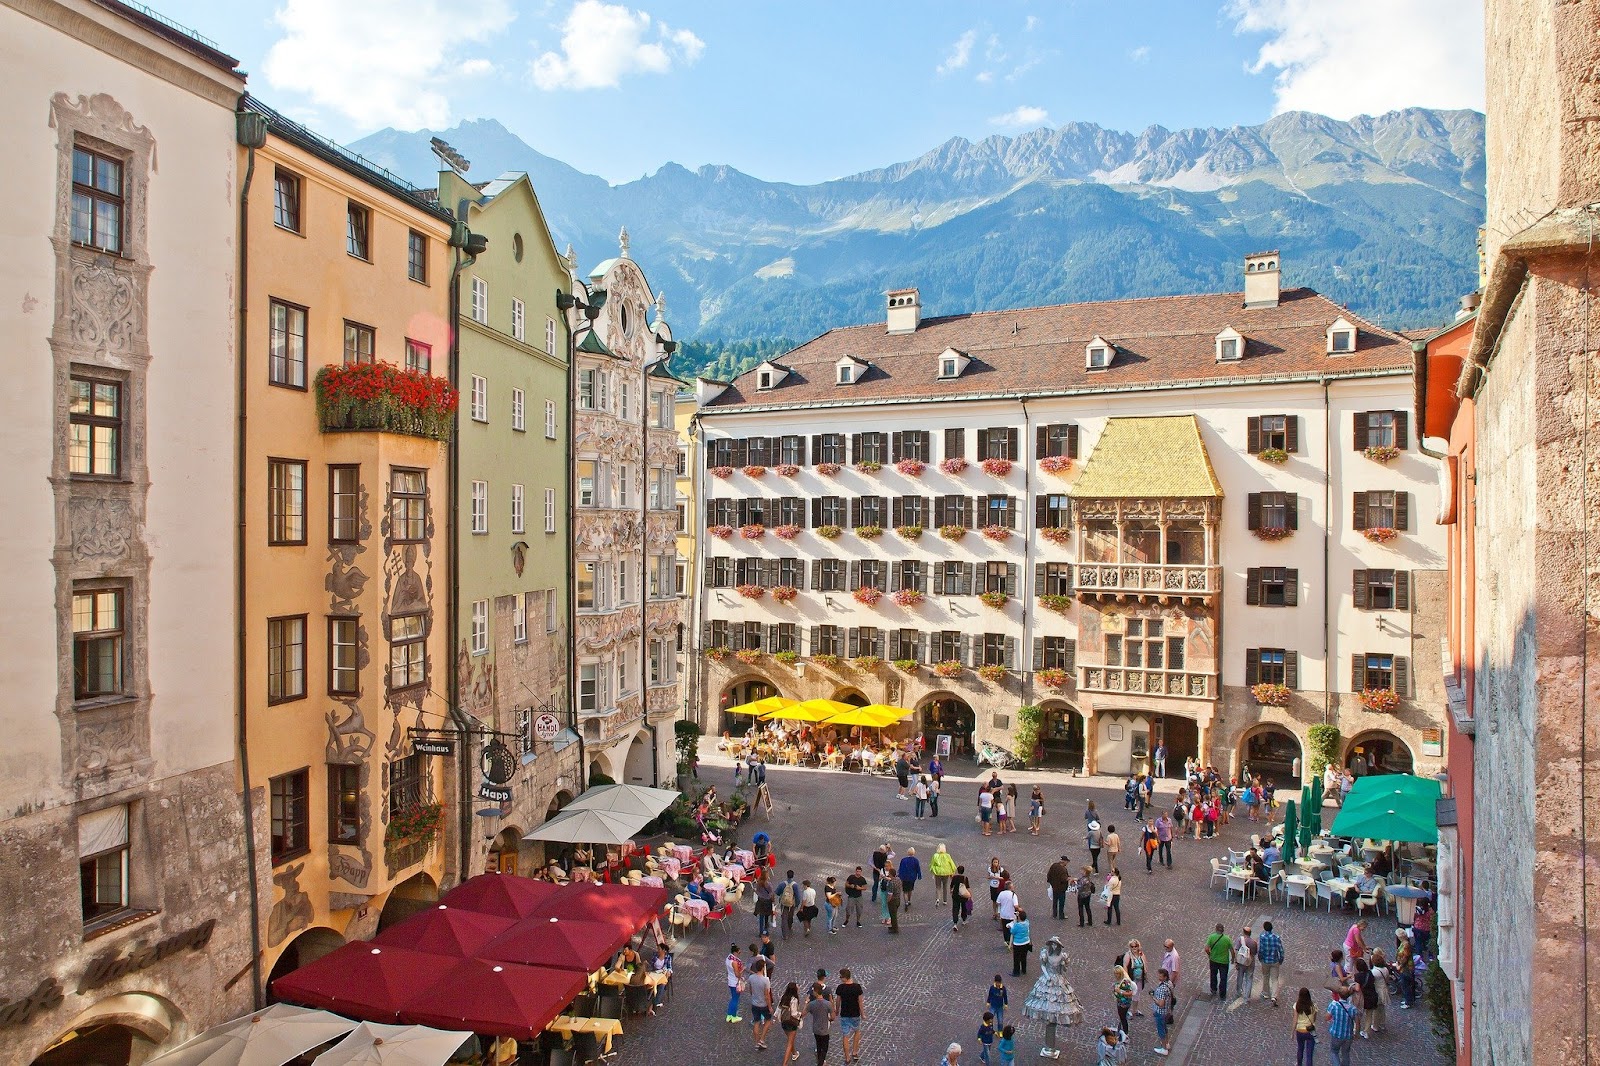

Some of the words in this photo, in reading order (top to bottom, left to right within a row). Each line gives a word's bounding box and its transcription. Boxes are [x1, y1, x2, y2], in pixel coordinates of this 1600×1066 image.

[415, 743, 450, 753] Weinhaus
[481, 788, 509, 801] Happ
[337, 855, 366, 884] Happ
